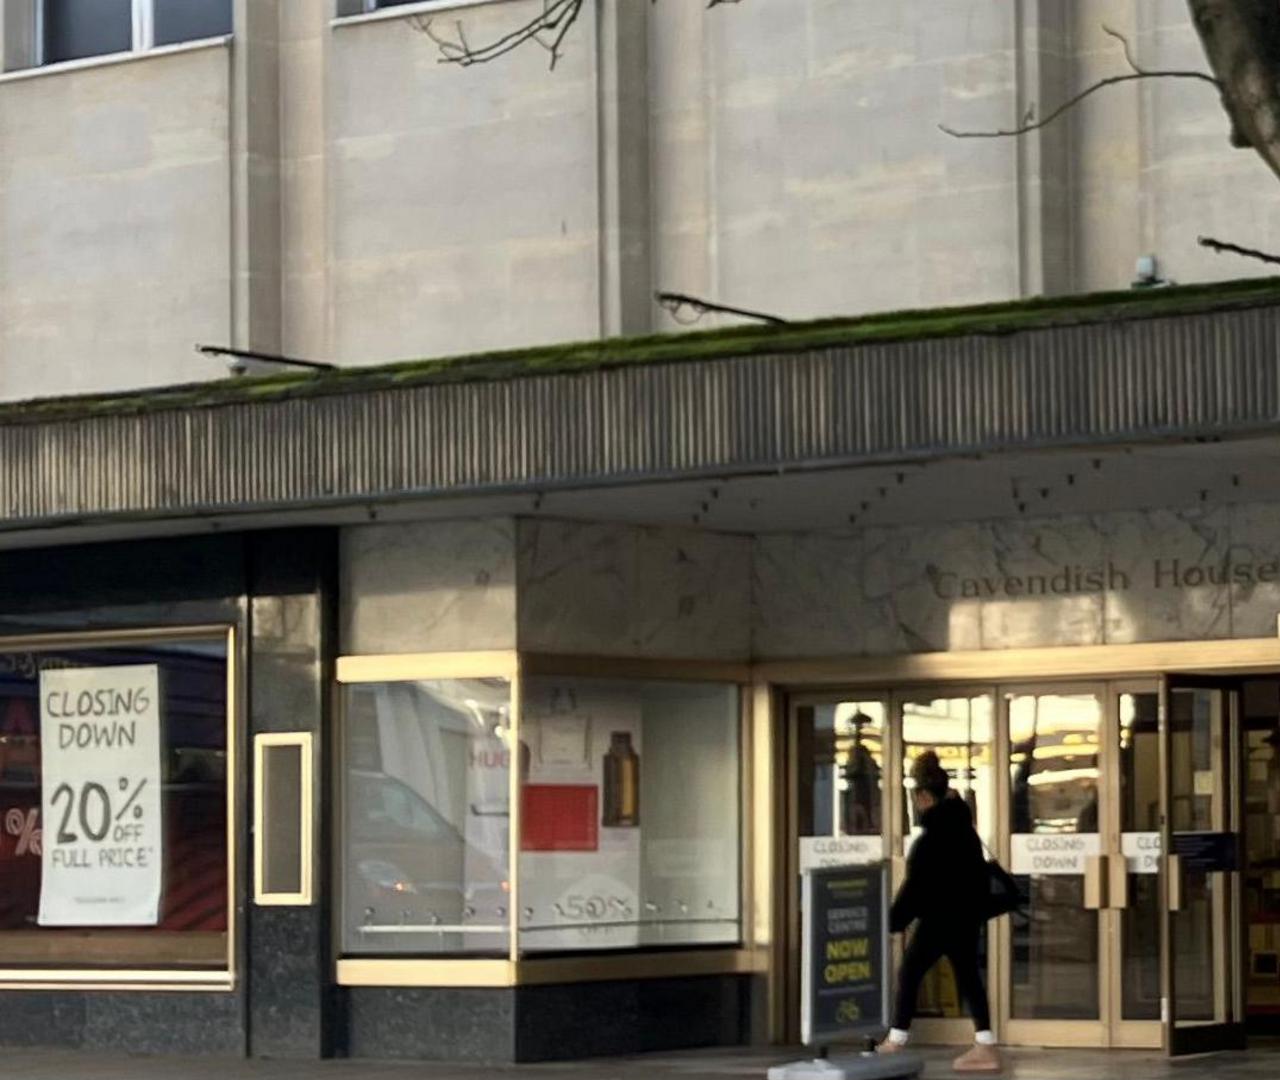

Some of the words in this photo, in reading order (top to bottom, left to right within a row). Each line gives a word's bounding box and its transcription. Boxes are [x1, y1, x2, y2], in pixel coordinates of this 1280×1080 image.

[935, 562, 1129, 599] Cavendish
[1154, 558, 1280, 589] House
[47, 687, 150, 718] CLOSING
[58, 721, 136, 750] DOWN
[50, 776, 148, 844] 20%
[113, 824, 144, 842] OFF
[1137, 837, 1161, 849] CLO
[1026, 838, 1085, 852] CLOSING
[51, 848, 91, 868] FULL
[1033, 856, 1077, 869] DOWN
[827, 938, 868, 960] NOW
[824, 961, 871, 984] OPEN
